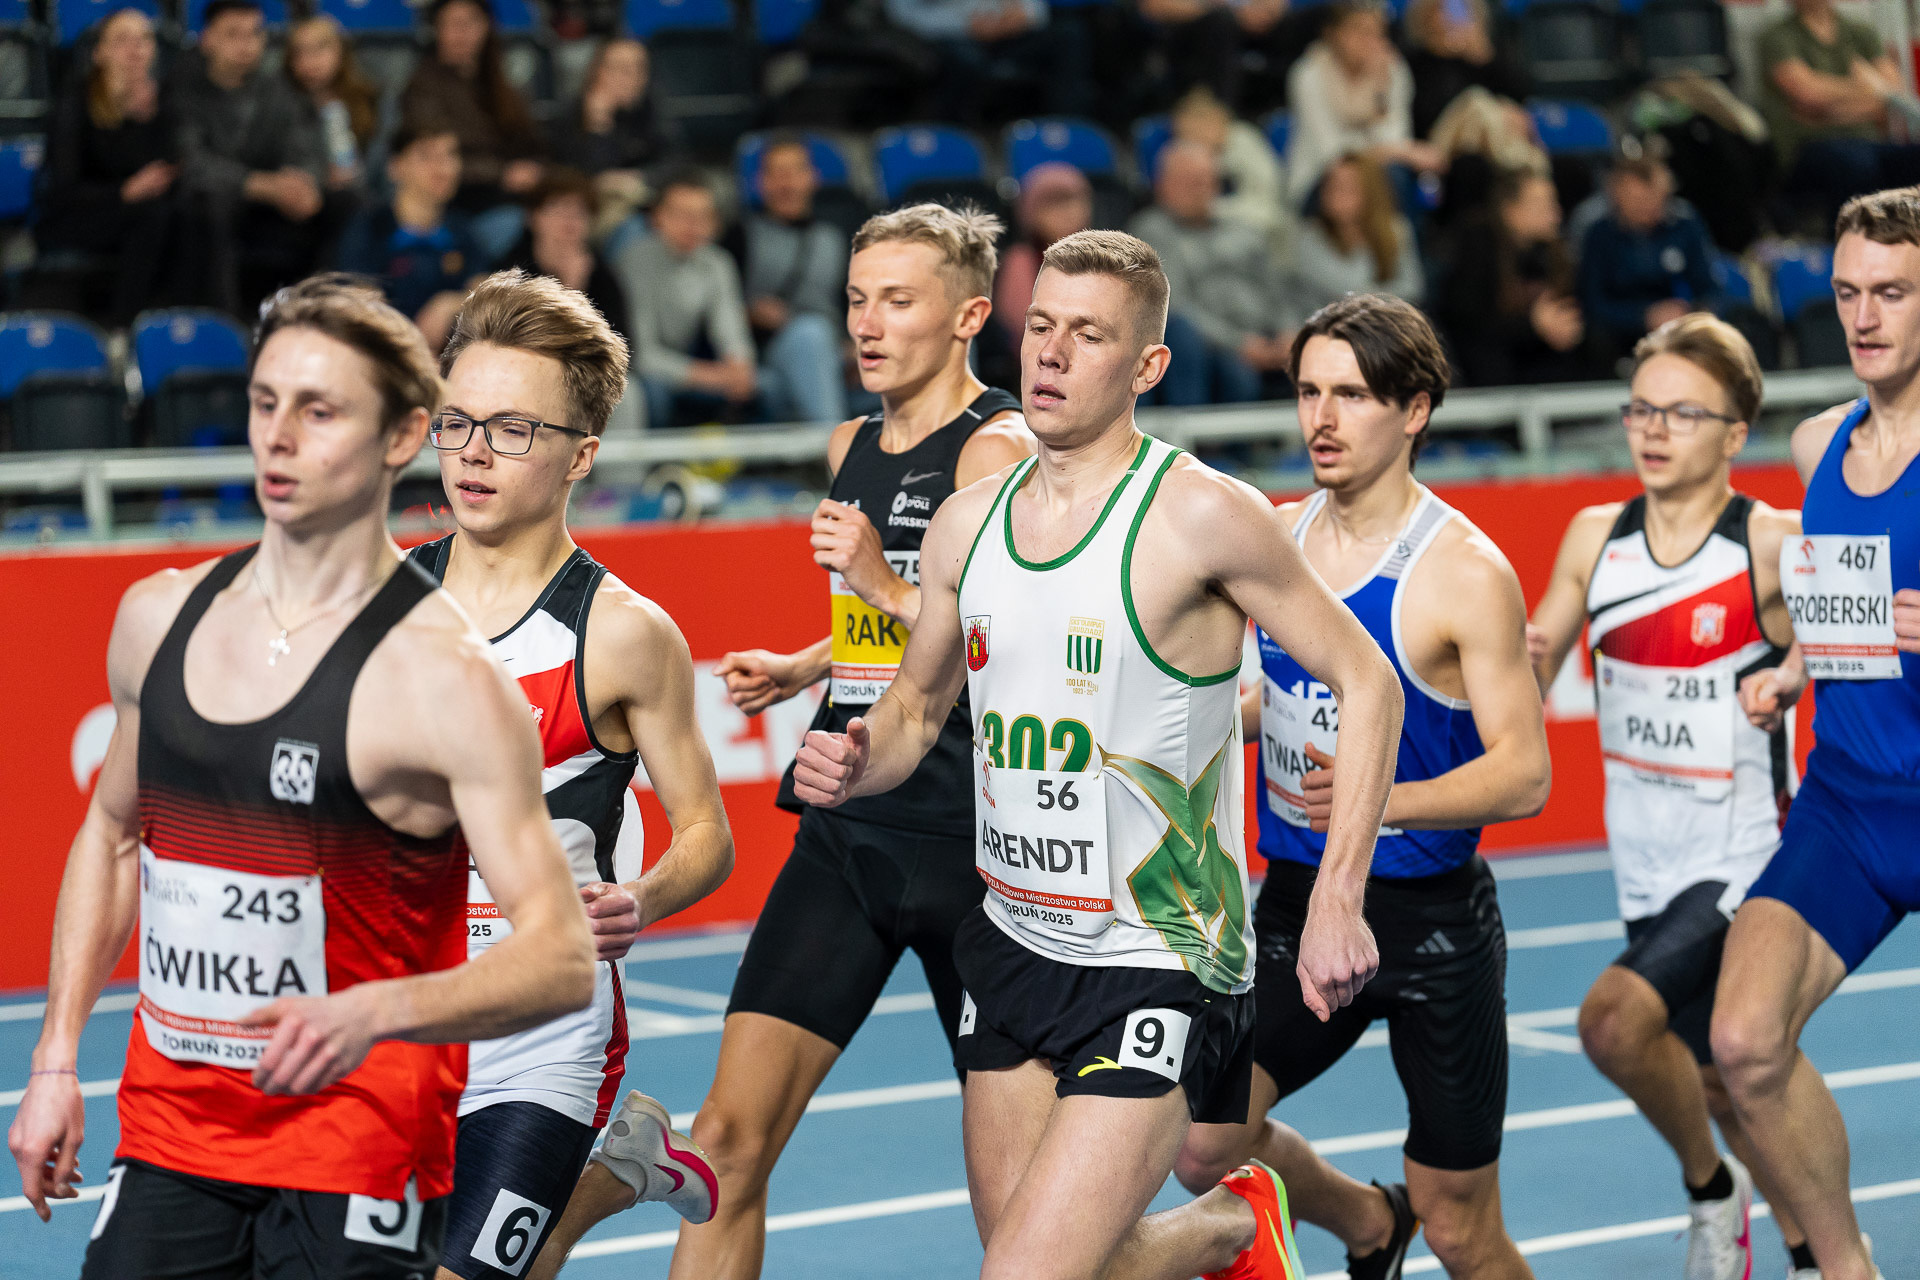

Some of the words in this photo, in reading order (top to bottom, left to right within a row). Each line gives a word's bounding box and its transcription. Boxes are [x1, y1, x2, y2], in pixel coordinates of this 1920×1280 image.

[1838, 543, 1877, 571] 467
[845, 612, 902, 647] RAK
[1076, 679, 1087, 688] LAT
[1666, 674, 1718, 700] 281
[982, 710, 1094, 773] 302
[1626, 717, 1695, 750] PAJA
[1037, 779, 1080, 811] 56
[983, 819, 1094, 875] ARENDT
[222, 884, 301, 923] 243
[467, 907, 498, 916] ostwa
[1000, 883, 1025, 900] Halowe
[1025, 891, 1077, 908] Mistrzostwa
[1078, 900, 1106, 910] Polski
[1000, 898, 1039, 920] TORUŃ
[1041, 910, 1073, 926] 2025
[146, 926, 306, 997] ĆWIKŁA
[162, 1031, 219, 1055] TORUŃ
[224, 1044, 265, 1060] 202
[1133, 1016, 1175, 1068] 9.
[494, 1206, 539, 1267] 6
